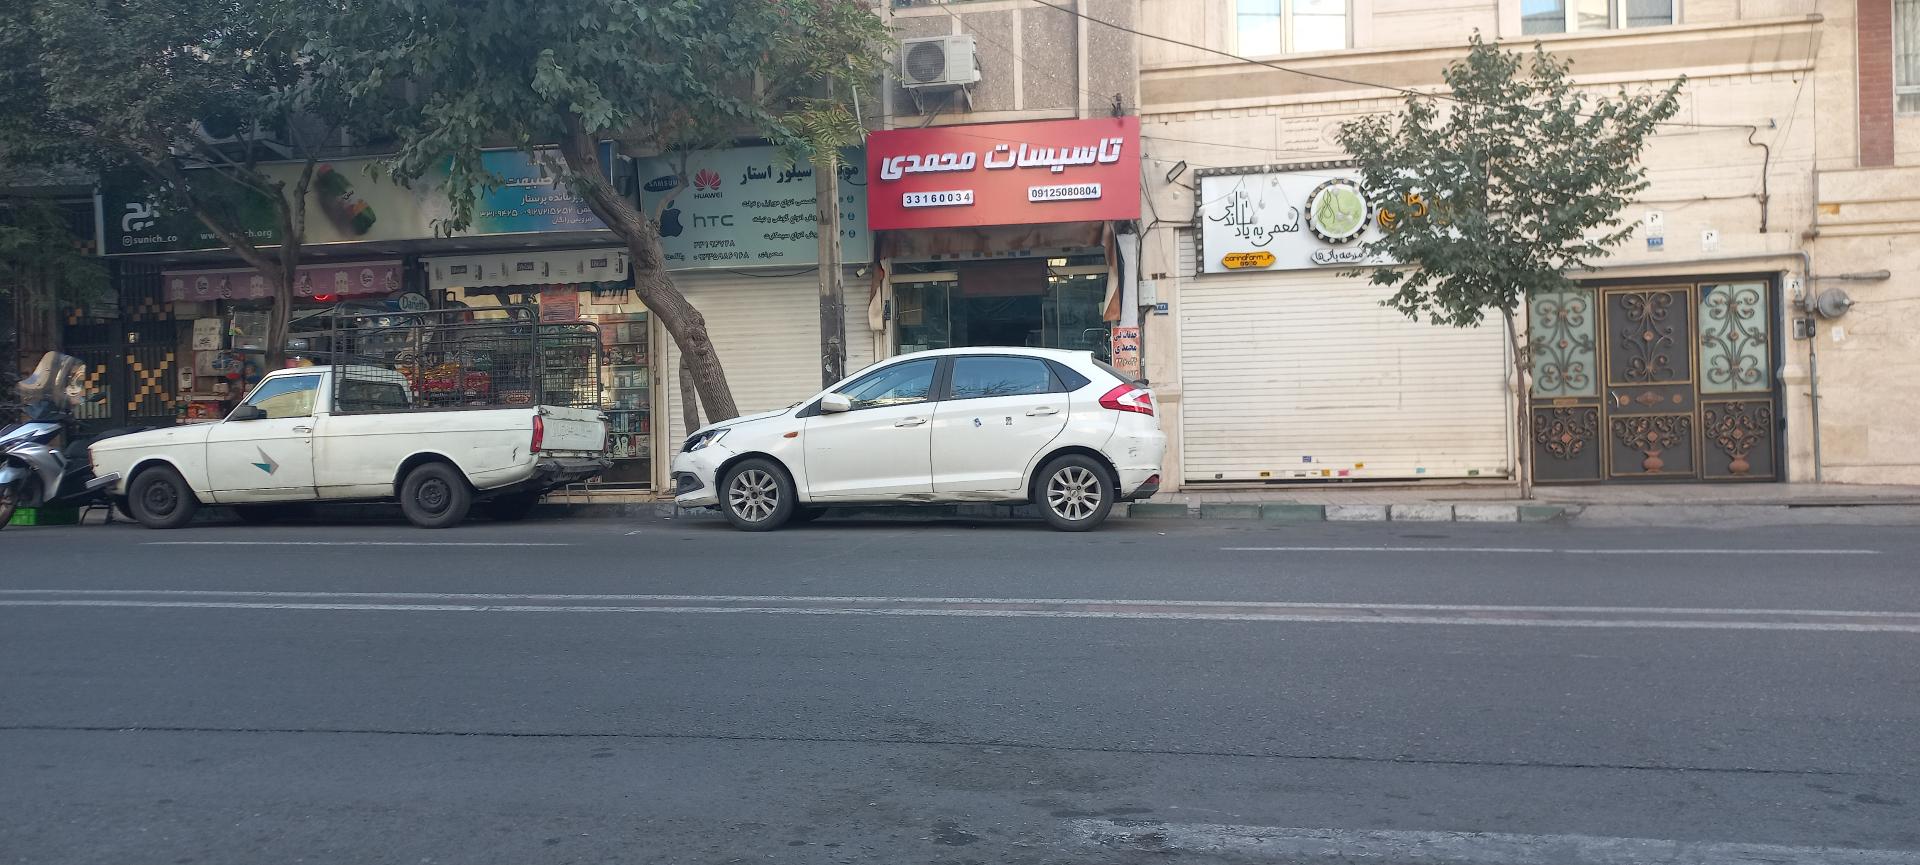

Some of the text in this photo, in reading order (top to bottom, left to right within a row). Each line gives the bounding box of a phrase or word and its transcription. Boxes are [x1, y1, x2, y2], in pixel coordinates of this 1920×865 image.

[880, 136, 1123, 181] تاسیسات محمدی
[740, 165, 772, 185] استار
[777, 163, 812, 183] سیلور
[694, 191, 723, 199] HUAWEI
[905, 193, 971, 205] 33160034
[1031, 186, 1098, 199] 09125080804
[1251, 206, 1299, 247] طعمی
[1253, 225, 1264, 239] به
[133, 234, 178, 245] sunich_co
